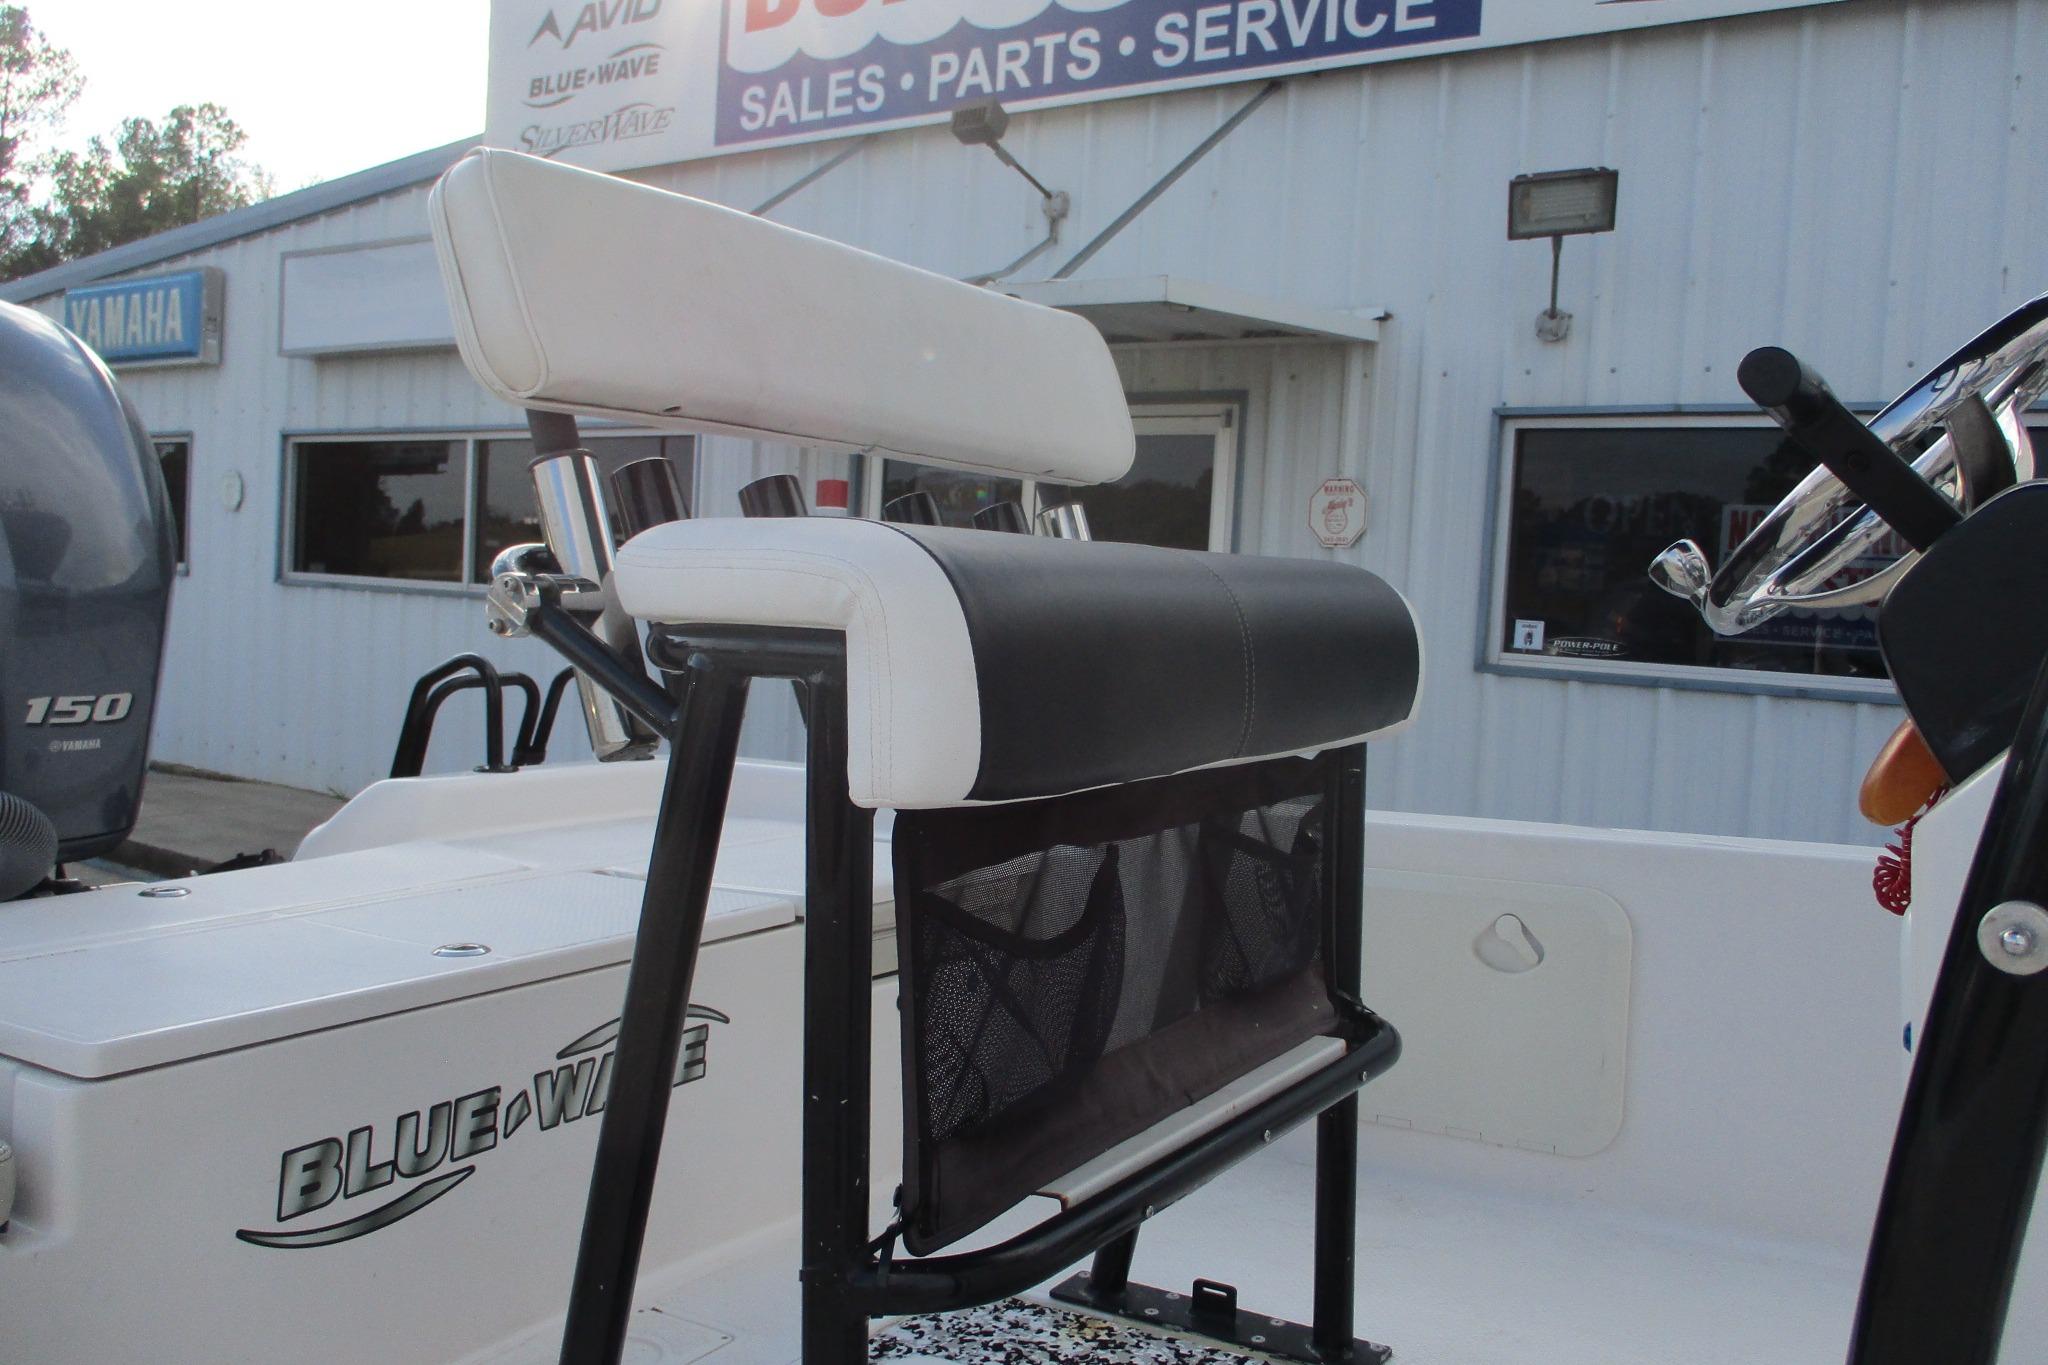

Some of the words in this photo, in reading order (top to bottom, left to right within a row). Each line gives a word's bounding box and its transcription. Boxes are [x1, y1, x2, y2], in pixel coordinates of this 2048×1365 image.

[562, 0, 662, 49] AVID
[529, 68, 586, 98] BLUE
[597, 54, 660, 82] WAVE
[740, 65, 886, 131] SALES
[929, 28, 1101, 102] PARTS
[1152, 0, 1437, 68] SERVICE
[71, 288, 183, 348] YAMAHA
[1553, 639, 1619, 652] POWER-POLE
[25, 692, 132, 725] 150
[62, 738, 101, 751] YAMAHA
[276, 1085, 503, 1222] BLUE
[534, 1024, 709, 1131] WE
